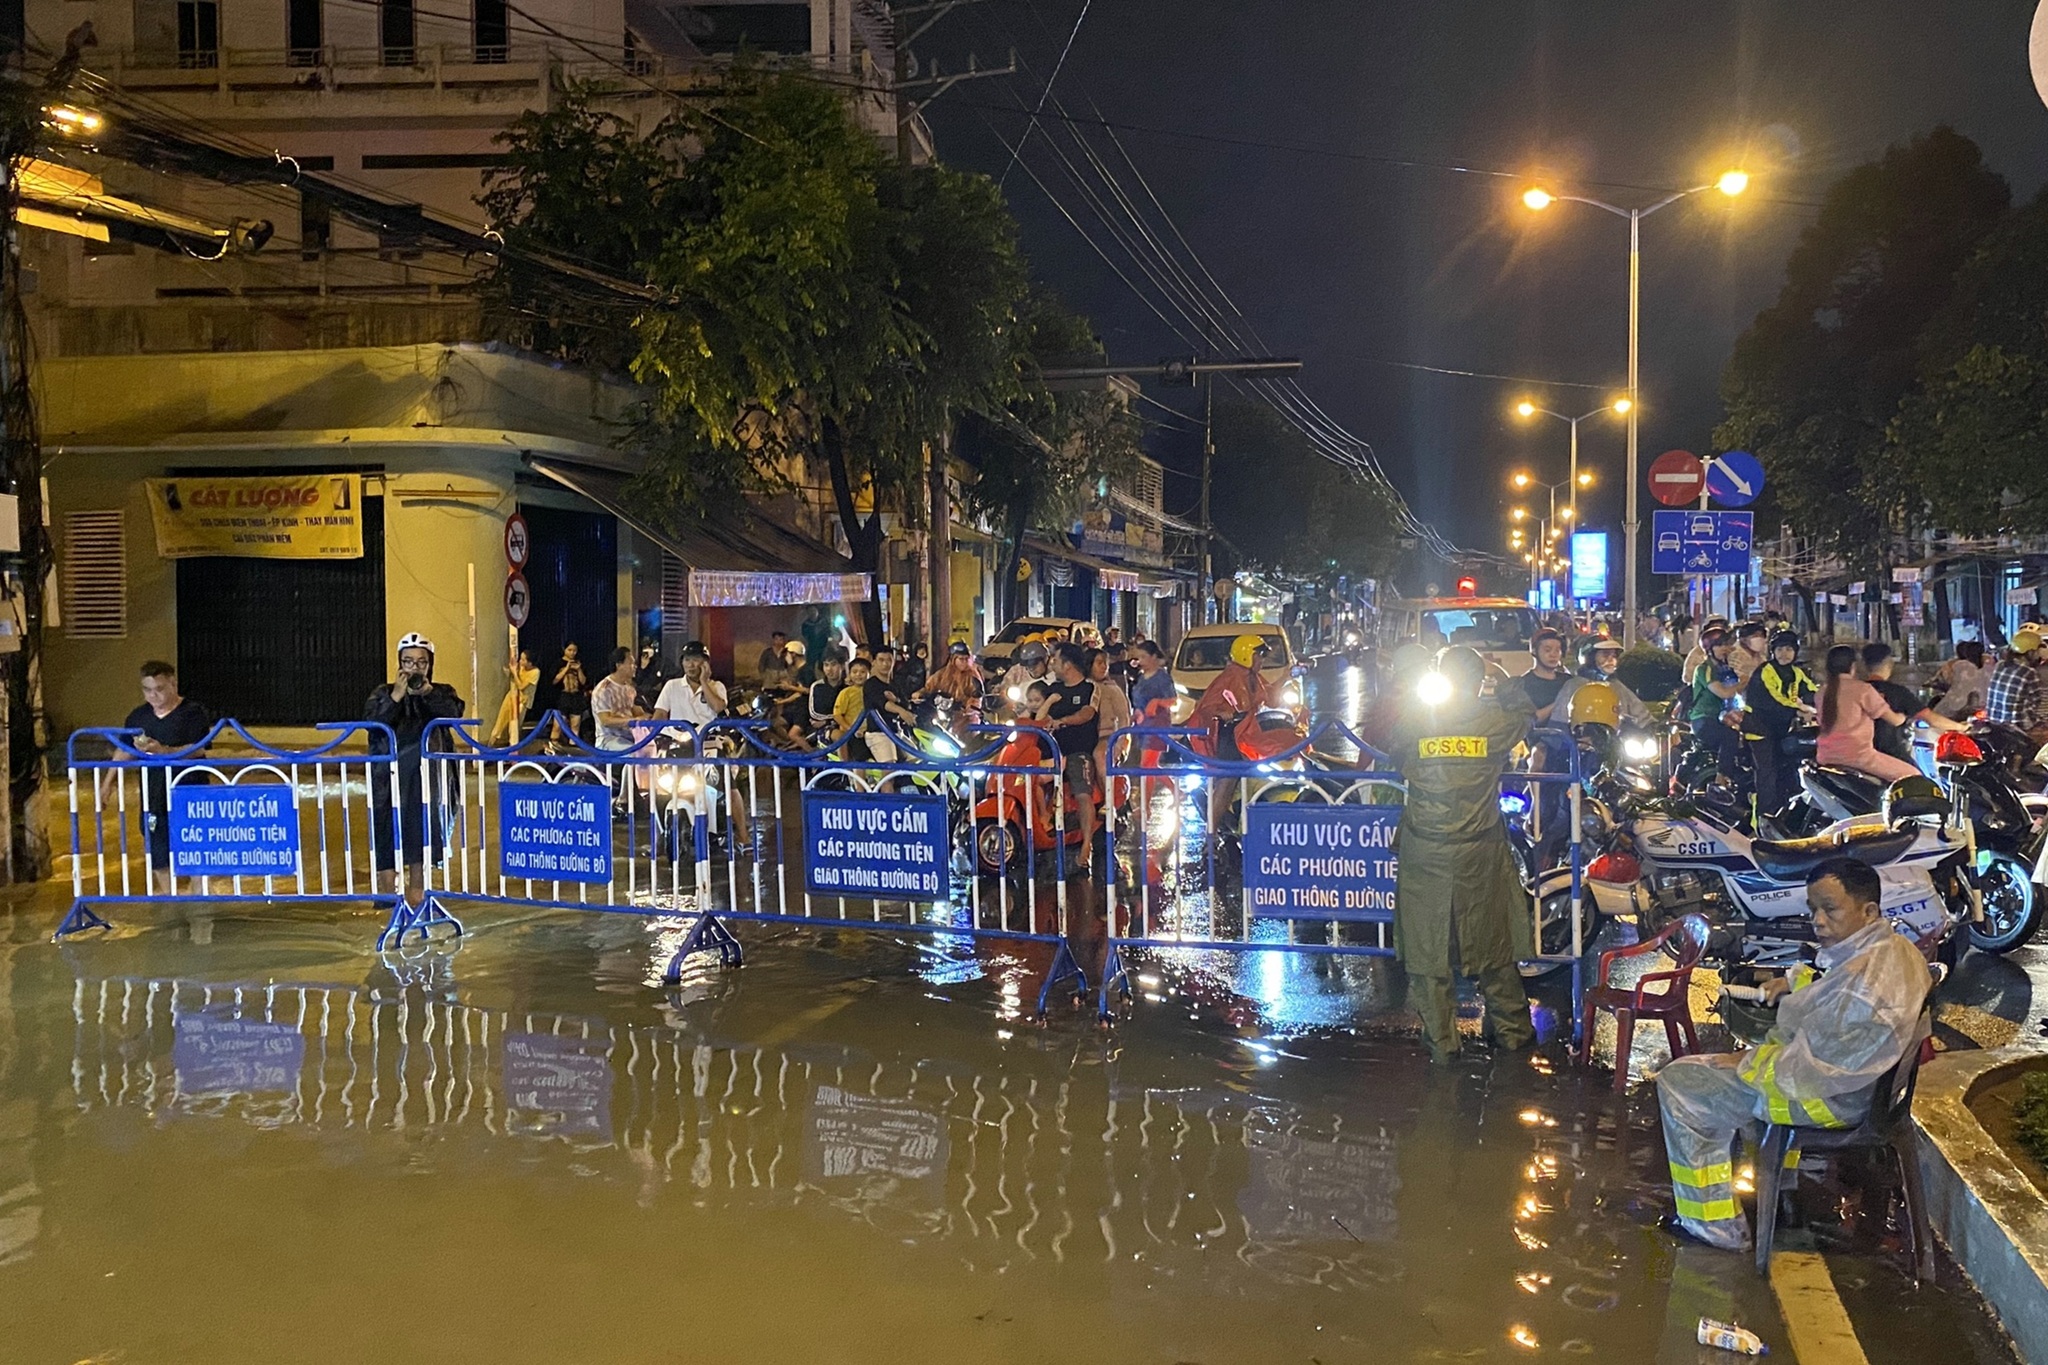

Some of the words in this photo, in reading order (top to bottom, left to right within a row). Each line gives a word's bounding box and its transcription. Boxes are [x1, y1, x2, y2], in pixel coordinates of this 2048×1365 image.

[235, 486, 320, 513] LƯỢNG
[305, 516, 322, 527] THAY
[187, 801, 214, 818] KHU
[218, 798, 245, 822] VỰC
[249, 794, 278, 818] CẤM
[515, 799, 538, 819] KHU
[542, 798, 564, 823] VỰC
[568, 795, 595, 822] CẤM
[822, 807, 852, 830] KHU
[856, 807, 887, 835] VỰC
[891, 804, 928, 834] CẤM
[181, 824, 203, 842] CÁC
[208, 825, 256, 842] PHƯƠNG
[260, 823, 287, 844] TIỆN
[1270, 823, 1308, 846] KHU
[1314, 821, 1352, 850] VỰC
[178, 851, 201, 865] GIAO
[204, 848, 238, 866] THÔNG
[241, 846, 277, 865] ĐƯỜNG
[279, 847, 293, 867] BỘ
[506, 852, 526, 868] GIAO
[528, 851, 557, 870] THÔNG
[560, 851, 590, 872] ĐƯỜNG
[818, 837, 843, 858] CÁC
[847, 840, 900, 861] PHƯƠNG
[904, 841, 933, 865] TIỆN
[1678, 841, 1716, 855] CSGT
[842, 866, 878, 888] THÔNG
[881, 867, 920, 890] ĐƯỜNG
[923, 871, 938, 894] BỘ
[1260, 853, 1291, 876] CÁC
[1299, 857, 1366, 878] PHƯƠNG
[1373, 856, 1399, 882] TIỆ
[1255, 887, 1286, 906] GIAO
[1291, 885, 1339, 908] THÔNG
[1345, 886, 1395, 910] ĐƯỜNG
[1750, 891, 1792, 902] POLICE
